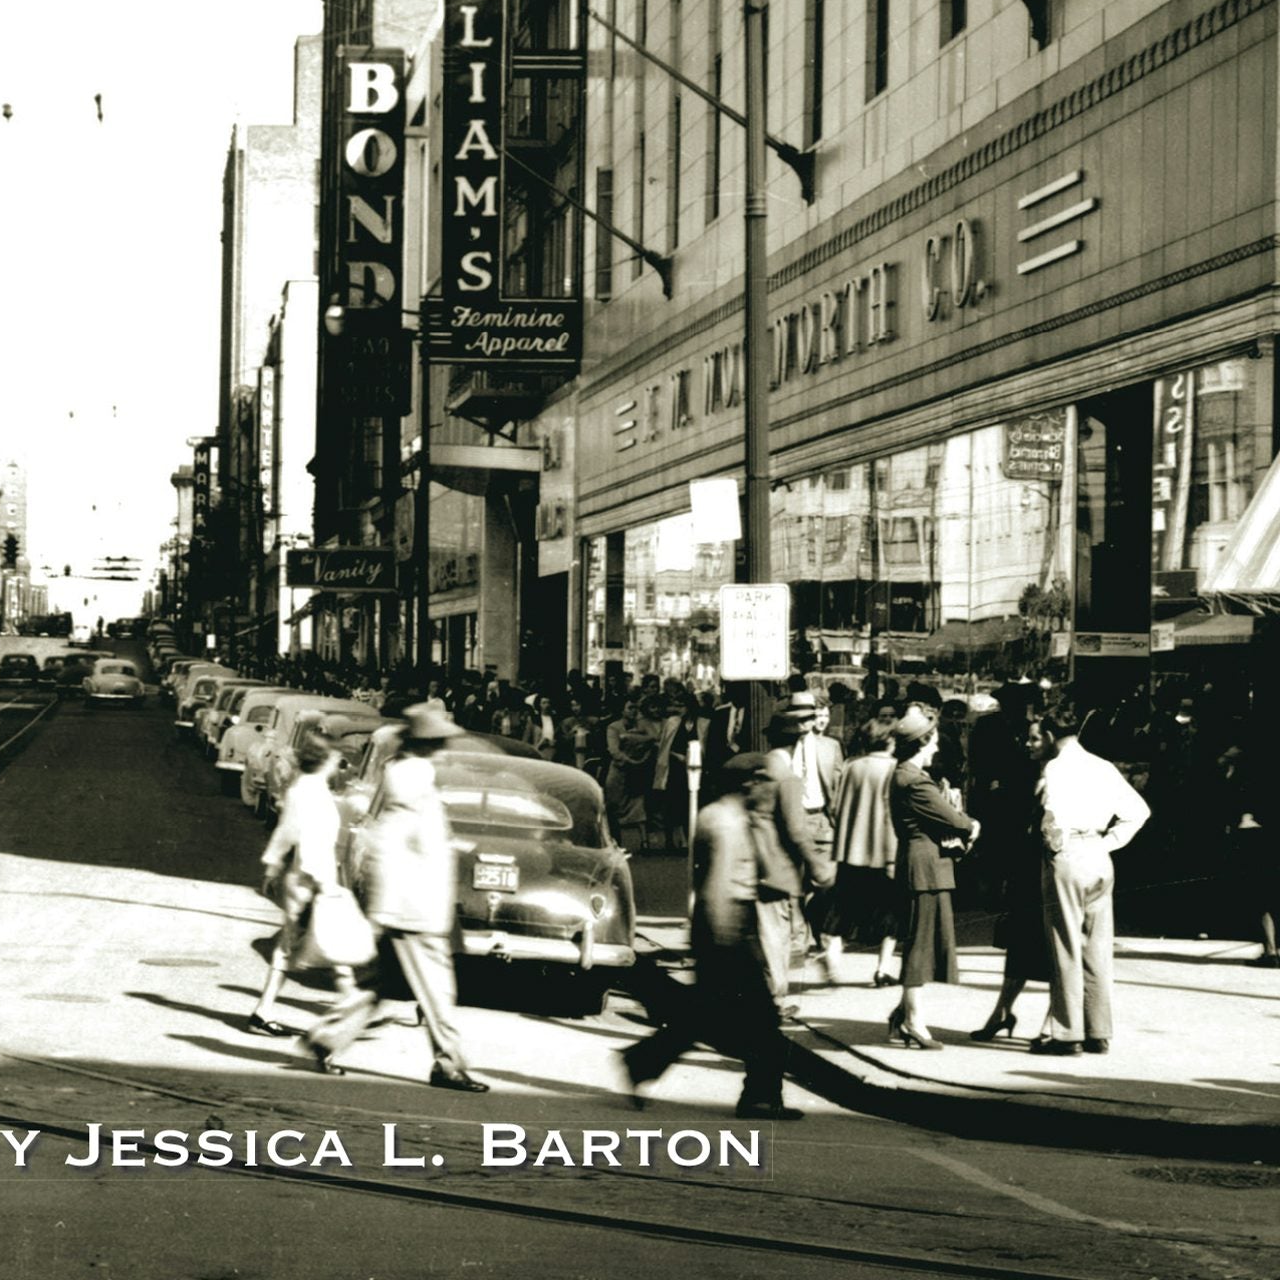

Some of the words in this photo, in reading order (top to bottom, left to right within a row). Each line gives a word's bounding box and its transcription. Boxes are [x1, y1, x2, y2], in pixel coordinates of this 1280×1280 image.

[345, 62, 399, 308] BOND
[451, 306, 565, 327] Feminine
[465, 331, 570, 357] Apparel
[704, 262, 893, 417] WOWORTH
